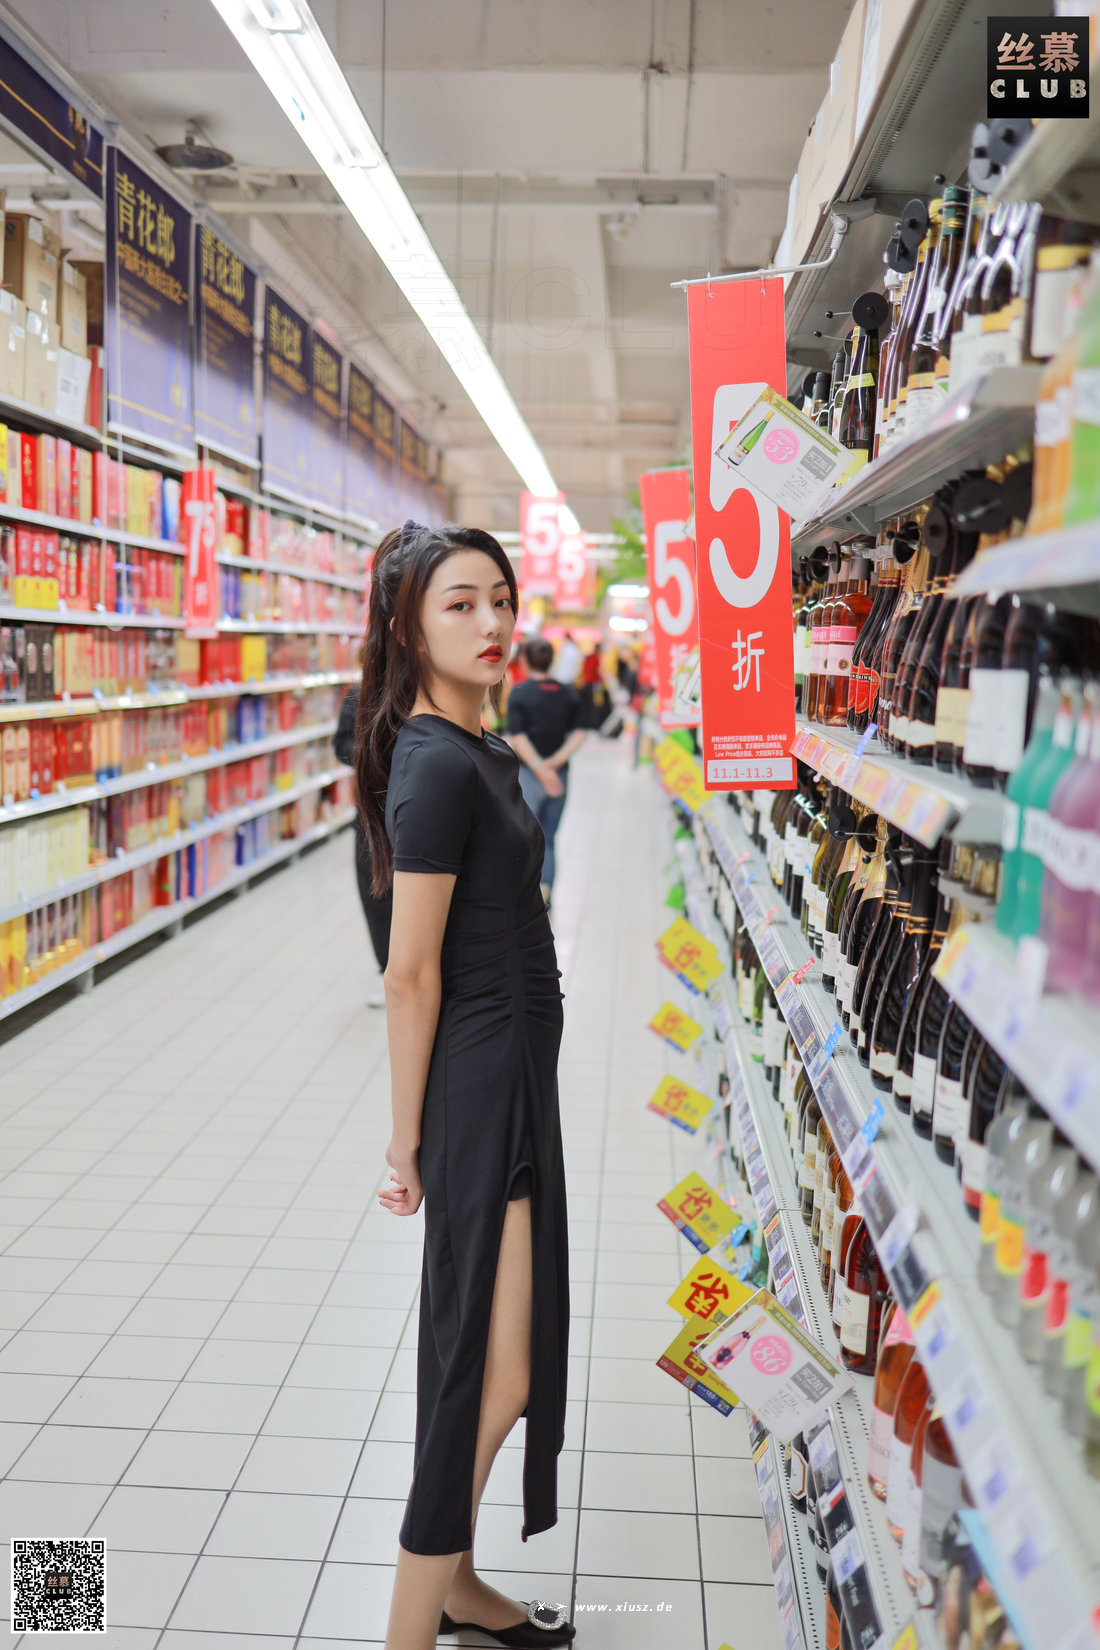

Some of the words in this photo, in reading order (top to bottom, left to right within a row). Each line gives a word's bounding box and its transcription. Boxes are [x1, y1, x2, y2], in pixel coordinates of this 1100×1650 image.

[115, 172, 176, 270] 青花郎
[708, 381, 780, 608] 5
[525, 501, 559, 557] 5
[557, 538, 586, 581] 5
[654, 520, 695, 637] 5
[731, 629, 765, 693] 折
[713, 767, 774, 779] 11.1-11.3
[678, 1187, 713, 1221] 省
[684, 1273, 729, 1320] 省
